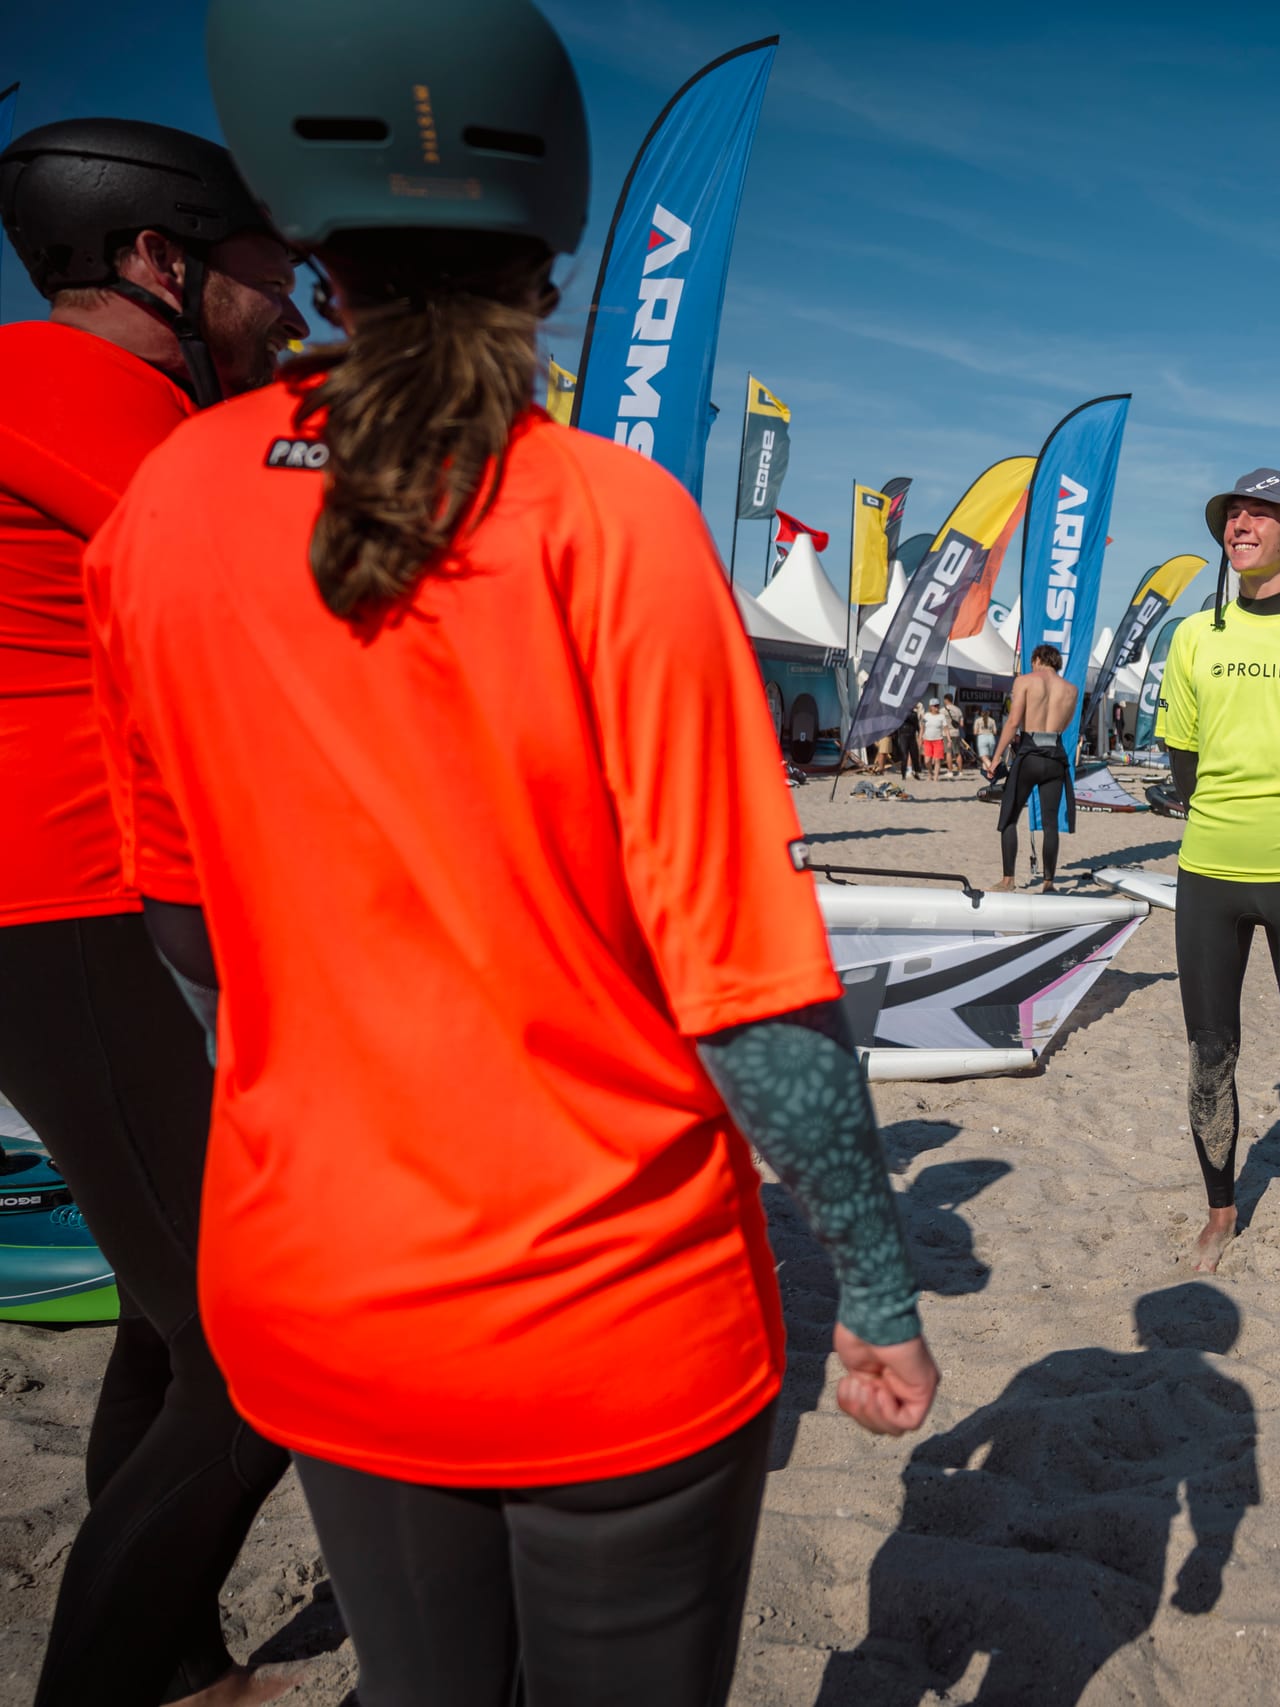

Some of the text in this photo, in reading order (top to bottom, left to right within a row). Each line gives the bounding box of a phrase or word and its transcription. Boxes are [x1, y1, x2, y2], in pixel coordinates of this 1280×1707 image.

[268, 440, 330, 468] PRO
[753, 430, 775, 506] CORE
[880, 540, 973, 708] CORE
[1043, 474, 1088, 677] ARMST
